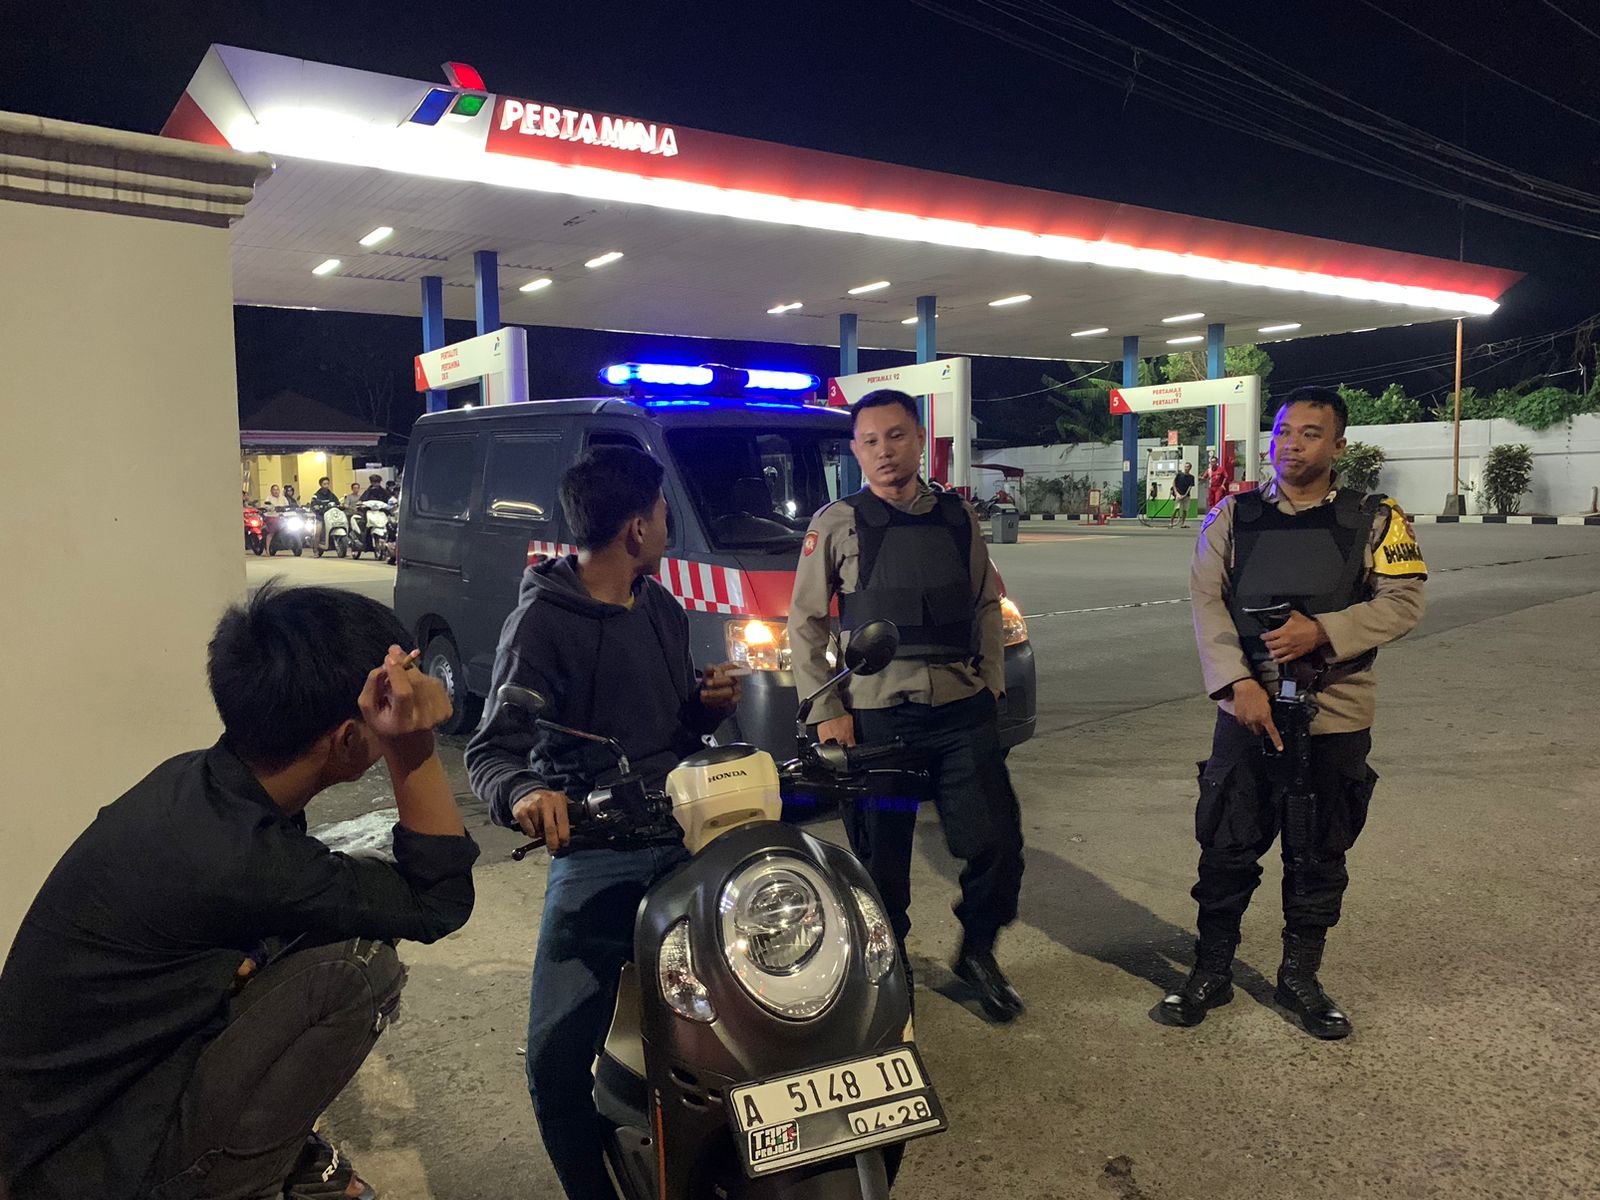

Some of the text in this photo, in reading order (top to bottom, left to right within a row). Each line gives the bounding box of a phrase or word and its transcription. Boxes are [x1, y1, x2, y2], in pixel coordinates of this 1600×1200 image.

[500, 99, 679, 157] PERTAMINA
[830, 386, 837, 397] 3
[1152, 387, 1181, 395] PERTAMAX
[1113, 397, 1119, 406] 5
[1152, 398, 1179, 406] PERTALITE
[707, 770, 747, 783] HONDA
[743, 1057, 913, 1128] A 5148 ID
[755, 1141, 794, 1159] PROJECT
